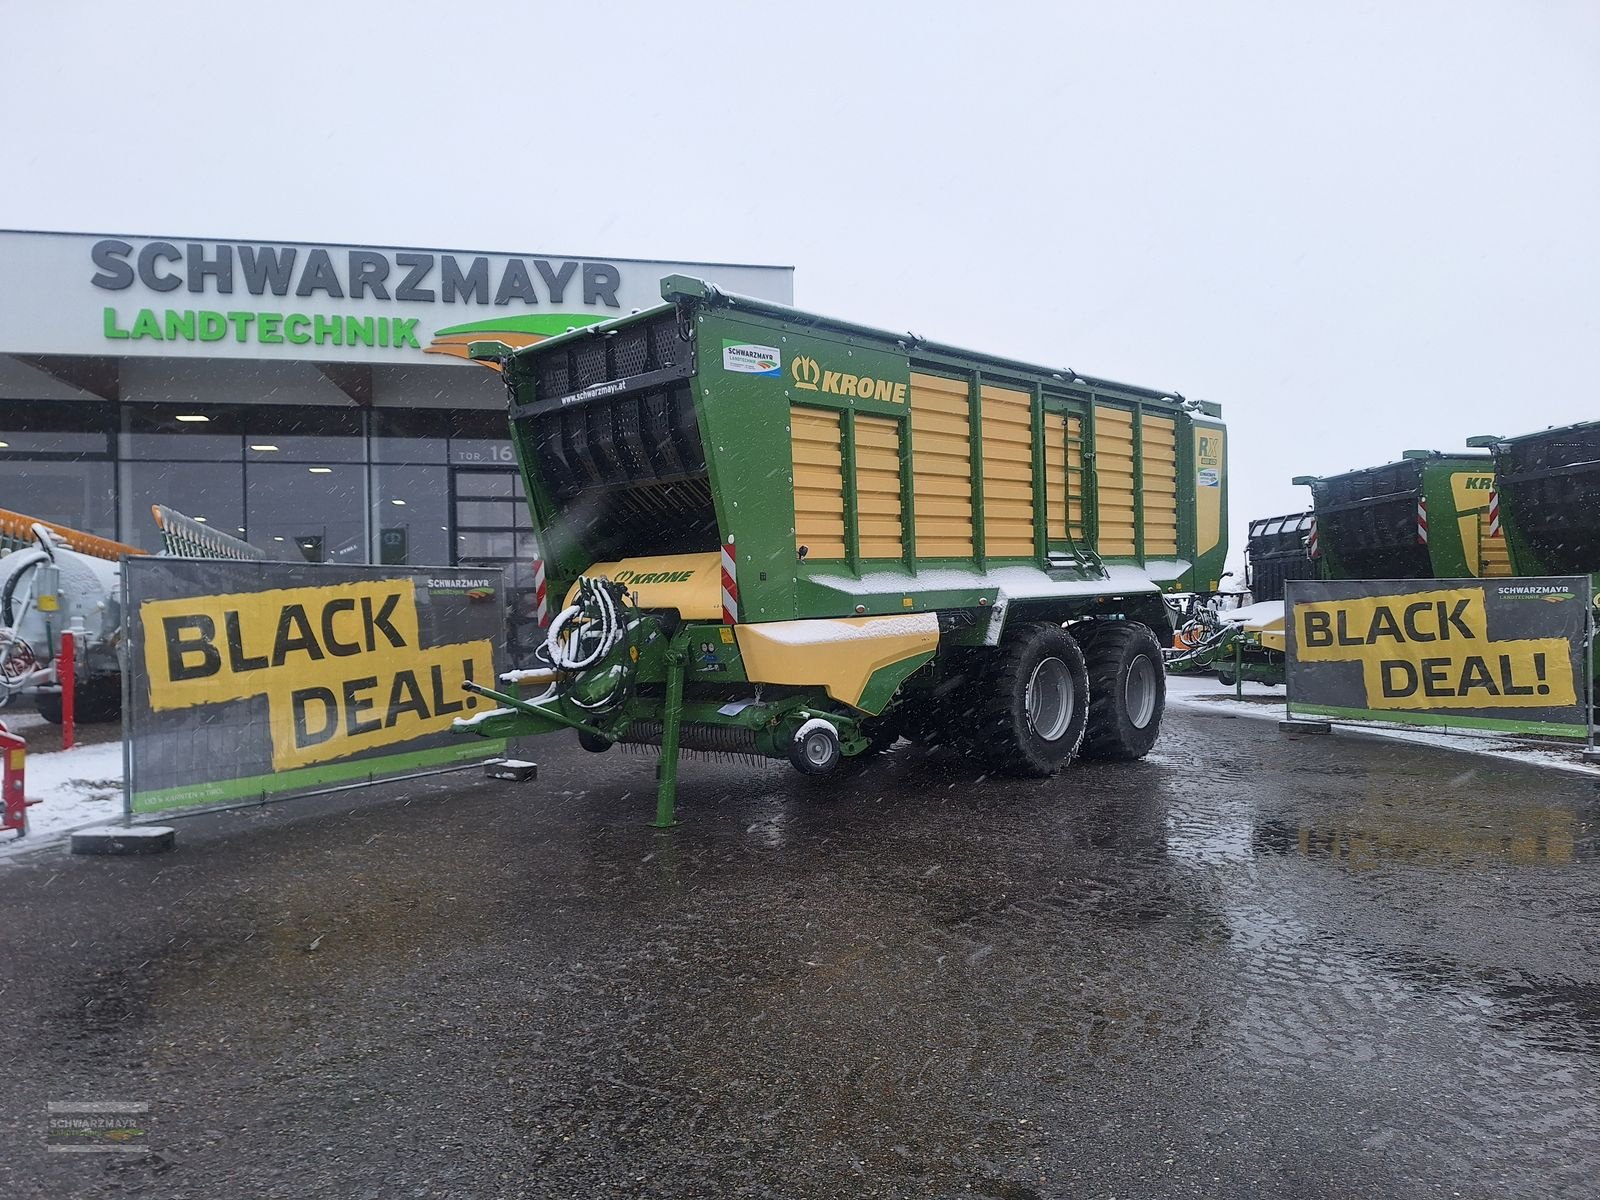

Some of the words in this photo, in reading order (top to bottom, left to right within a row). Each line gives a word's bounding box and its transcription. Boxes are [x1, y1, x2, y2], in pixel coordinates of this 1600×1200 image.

[91, 239, 620, 308] SCHWARZMAYR
[103, 307, 421, 349] LANDTECHNIK
[728, 347, 774, 360] SCHWARZMAYR
[561, 380, 626, 405] www.schwarzmayr.at
[822, 370, 907, 404] KRONE
[459, 451, 480, 460] TOR
[490, 445, 513, 461] 16
[1199, 436, 1218, 458] RX
[1465, 477, 1495, 489] KR
[428, 578, 489, 588] SCHWARZMAYR
[629, 570, 695, 585] KRONE
[1498, 586, 1569, 594] SCHWARZMAYR
[1304, 598, 1475, 648] BLACK
[161, 593, 406, 682] BLACK
[1380, 652, 1550, 698] DEAL!
[291, 657, 478, 750] DEAL!
